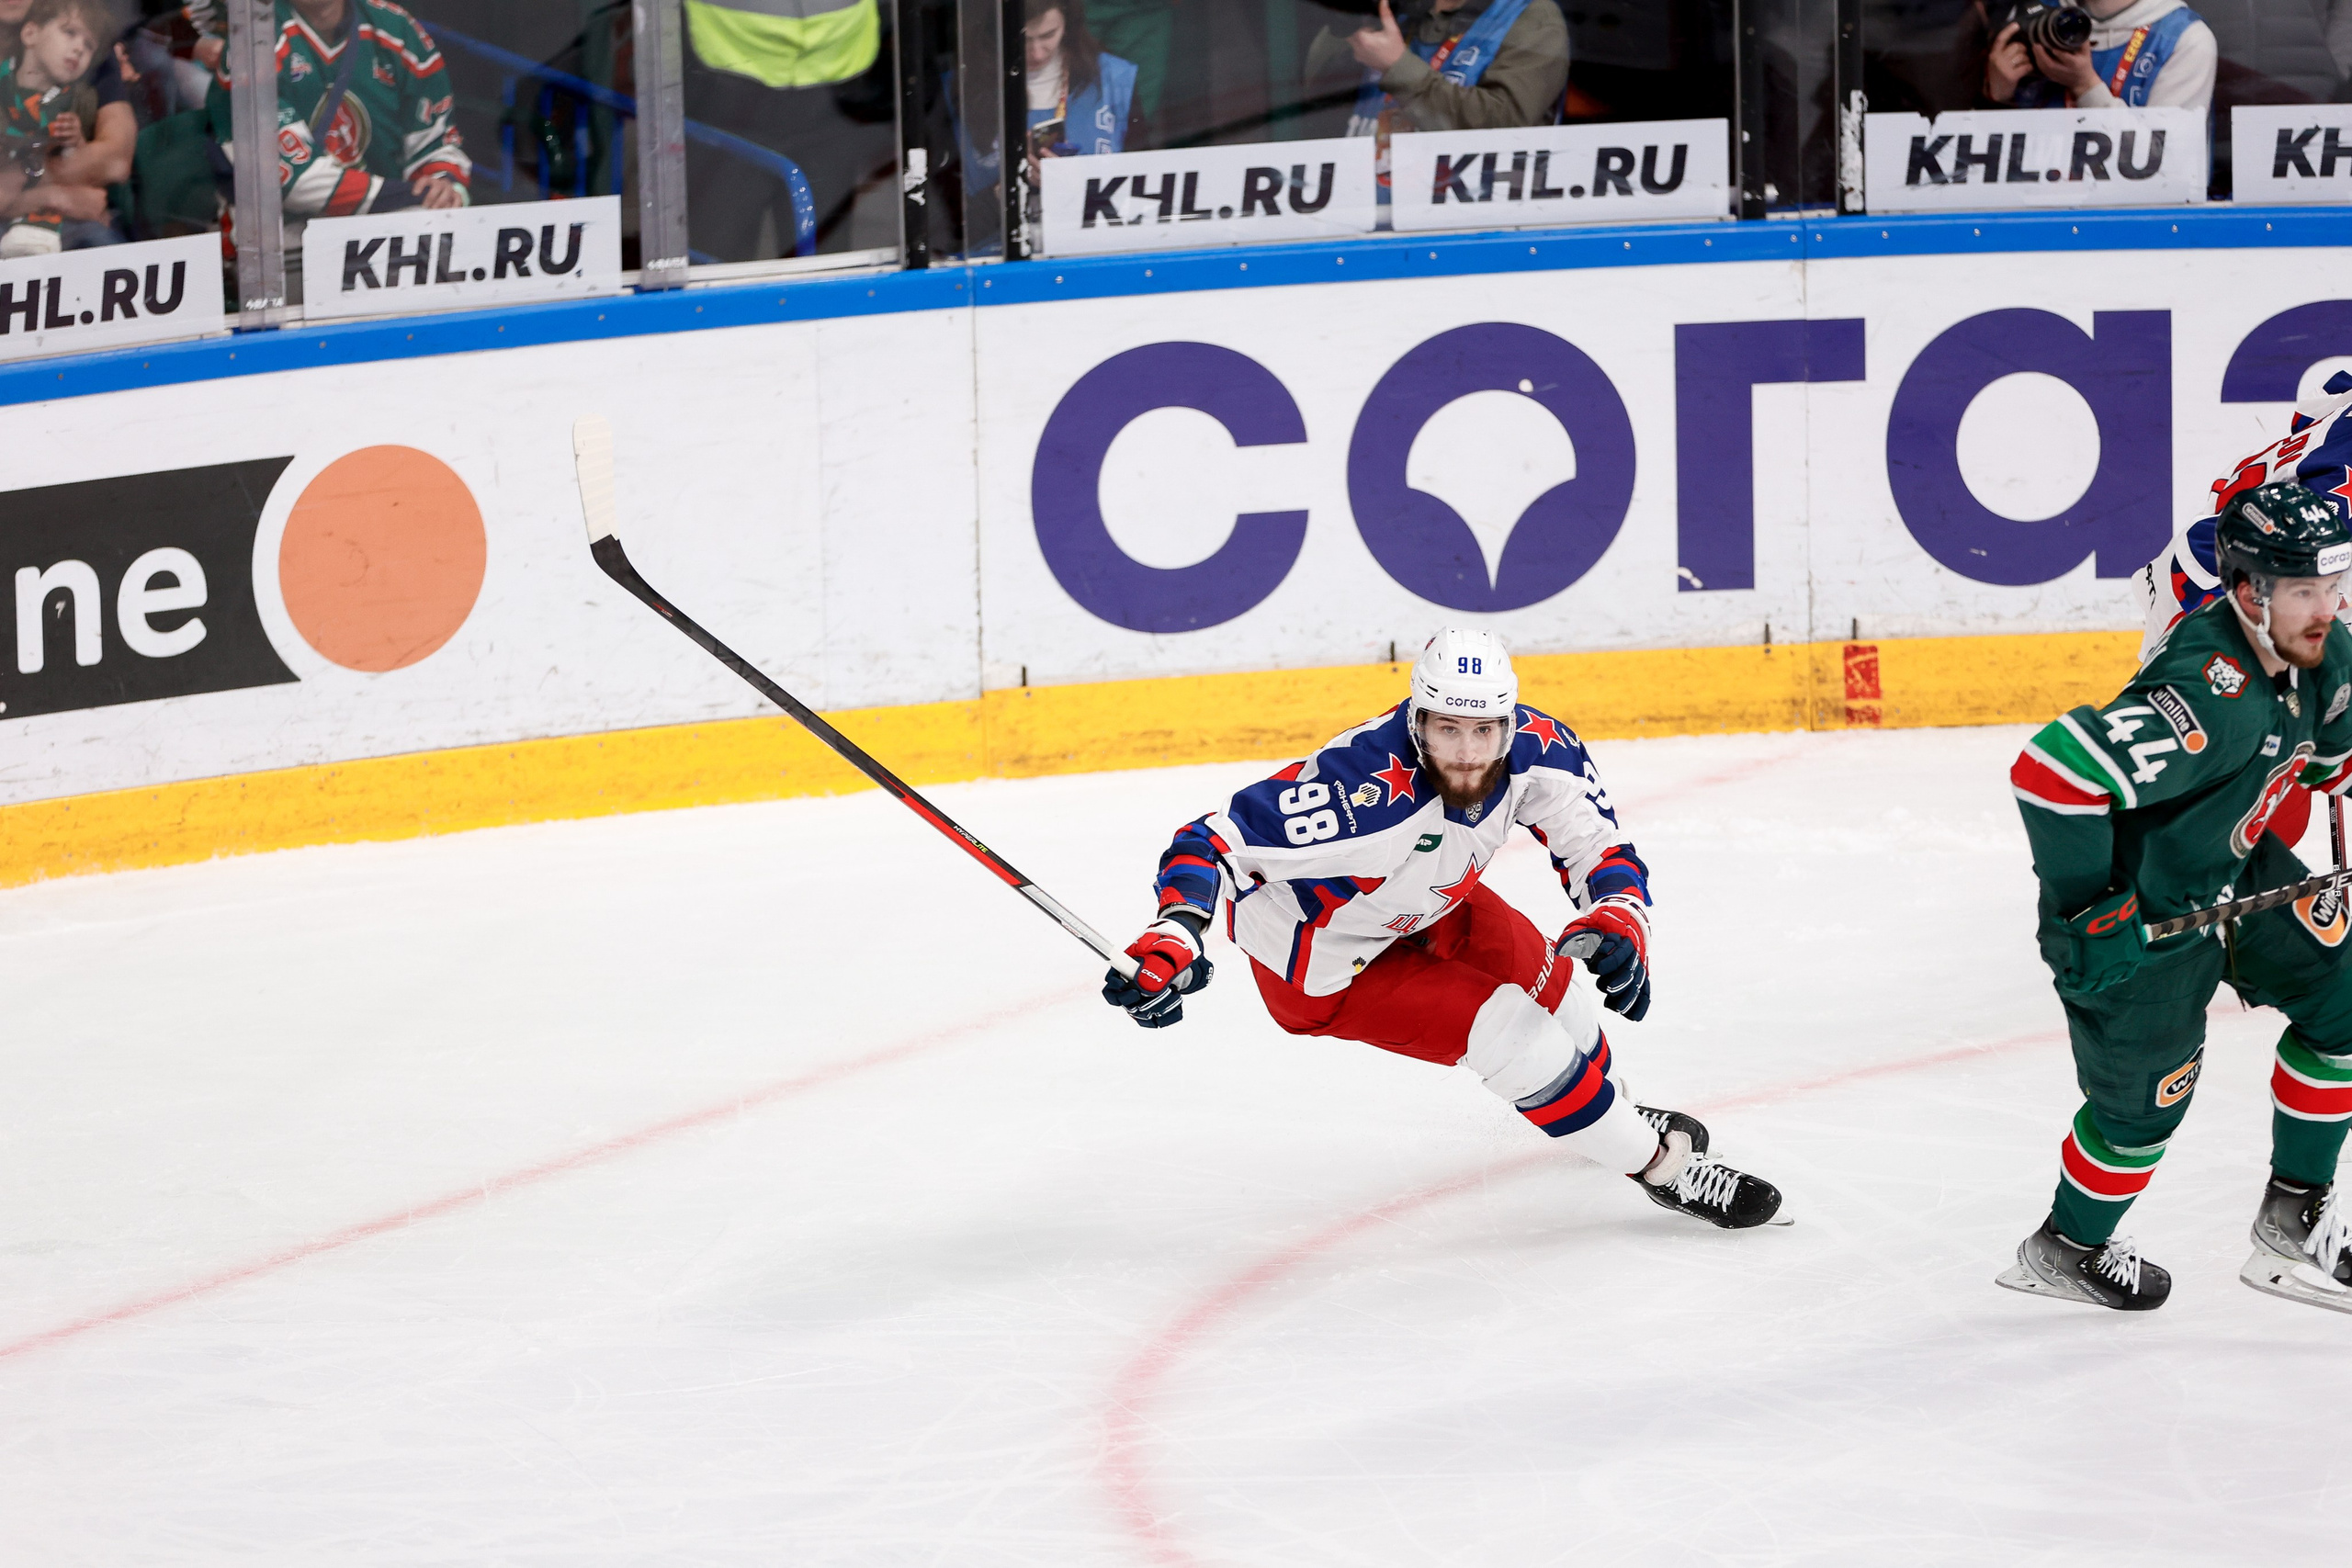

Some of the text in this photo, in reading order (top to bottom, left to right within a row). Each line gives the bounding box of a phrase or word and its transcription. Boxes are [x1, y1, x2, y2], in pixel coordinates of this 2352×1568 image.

[1431, 143, 1689, 205] KHL.RU
[1905, 130, 2166, 185] KHL.RU
[2272, 128, 2352, 178] KH
[1081, 162, 1336, 229] KHL.RU
[341, 222, 585, 292] KHL.RU
[2299, 504, 2331, 524] 44
[15, 547, 209, 674] ne
[1457, 657, 1482, 675] 98
[1445, 696, 1487, 708] согаз
[2101, 705, 2178, 784] 44
[1278, 782, 1340, 845] 98
[1333, 780, 1358, 834] РОСНЕФТЬ
[1141, 968, 1163, 983] CCM
